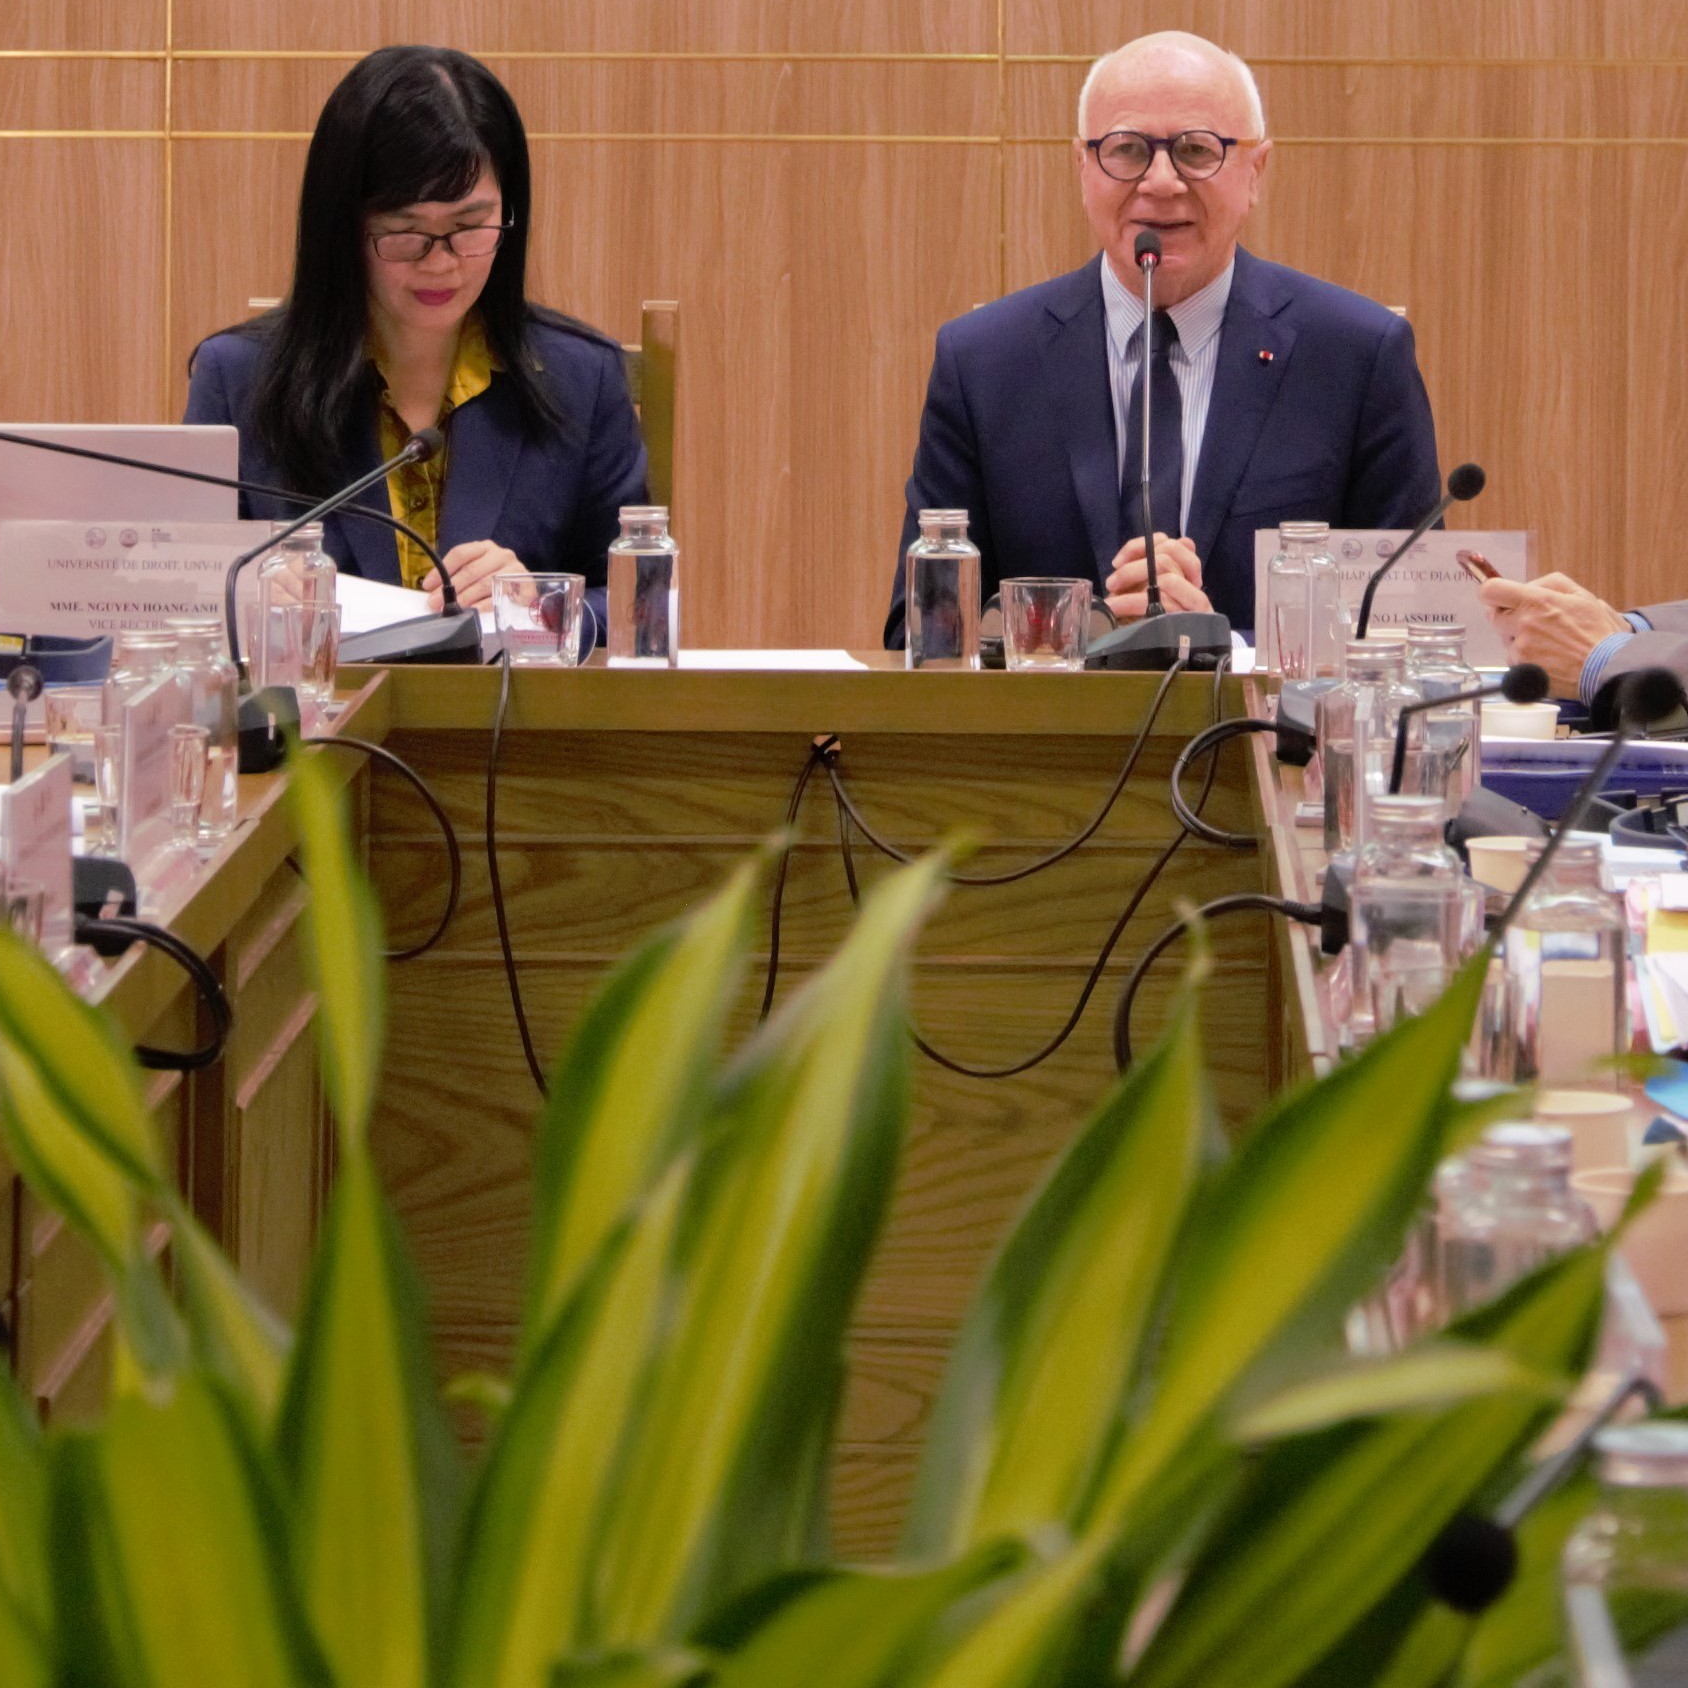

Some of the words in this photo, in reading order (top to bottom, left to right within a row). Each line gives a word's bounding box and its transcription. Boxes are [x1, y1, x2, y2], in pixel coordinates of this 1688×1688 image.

[47, 557, 119, 571] UNIVERSITÉ
[121, 559, 139, 570] DE
[1340, 569, 1365, 582] HÁP
[143, 602, 189, 613] HOANG
[192, 603, 218, 614] ANH
[88, 619, 116, 630] VICE
